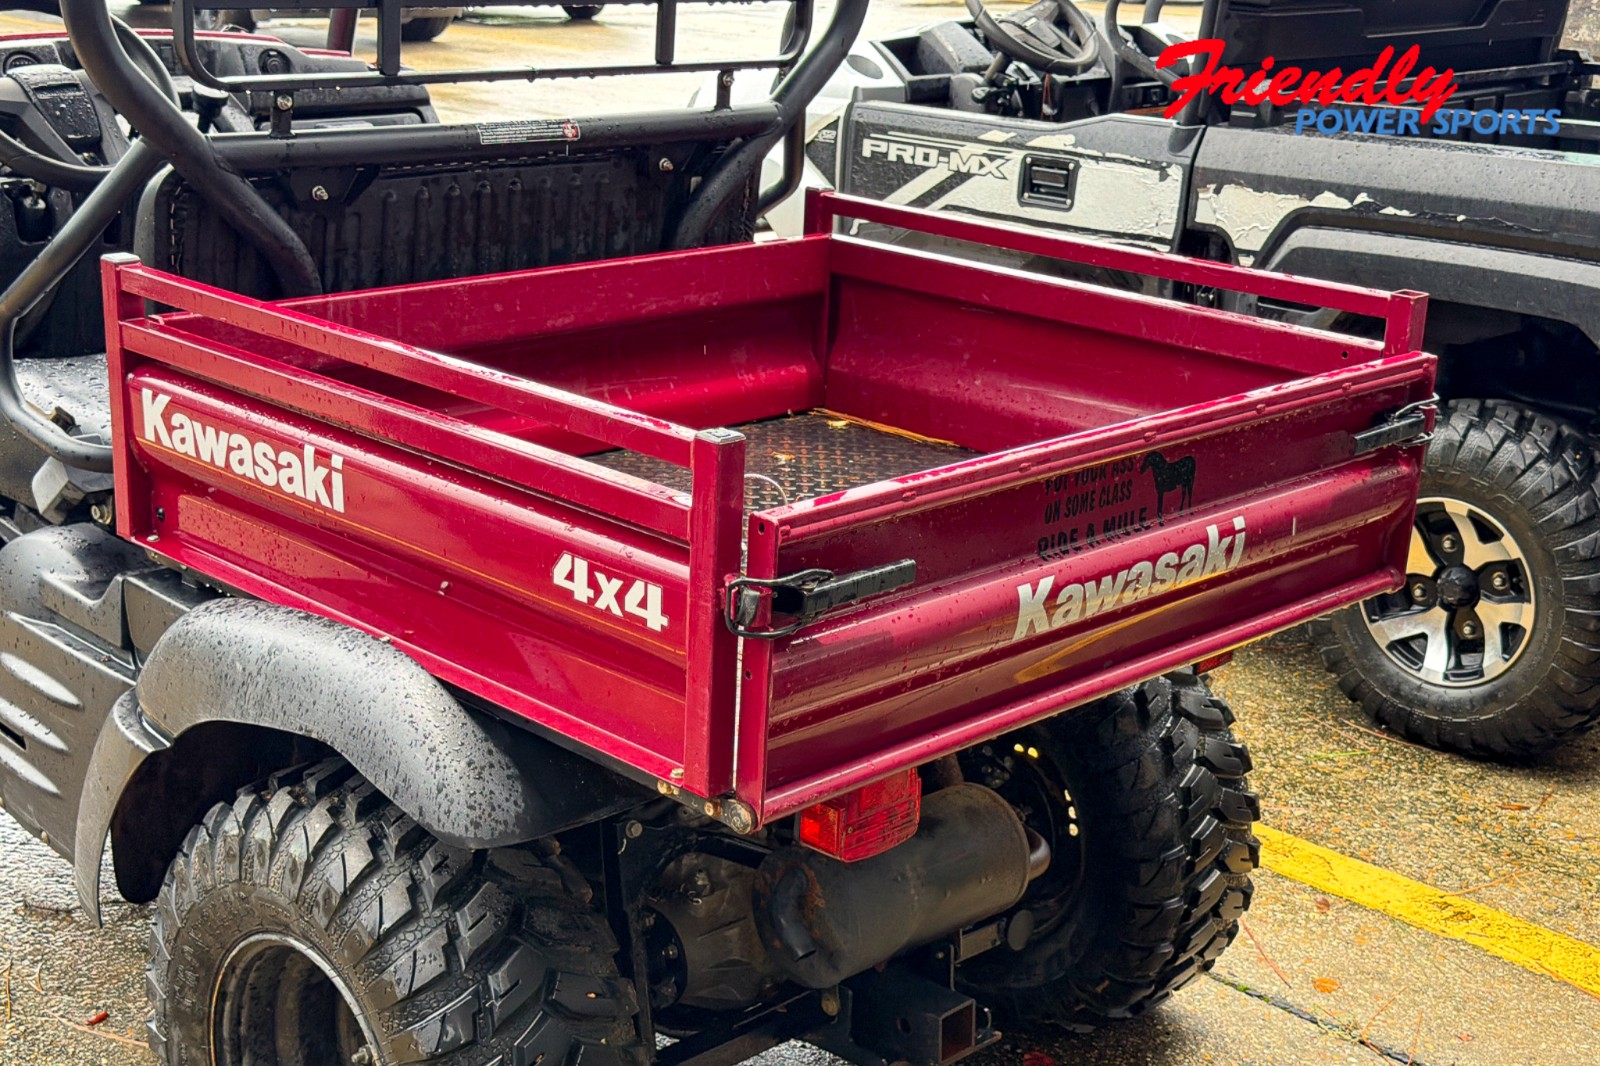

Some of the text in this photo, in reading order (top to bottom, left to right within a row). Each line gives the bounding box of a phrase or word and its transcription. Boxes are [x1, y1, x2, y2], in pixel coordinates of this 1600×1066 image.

[861, 138, 1008, 180] PRO-MX
[141, 387, 345, 513] Kawasaki
[1112, 456, 1136, 477] ASS
[1044, 479, 1133, 524] ON SOME CLASS
[1038, 507, 1152, 560] RIDE A MULE
[552, 551, 669, 632] 4x4
[1013, 515, 1247, 641] Kawasaki
